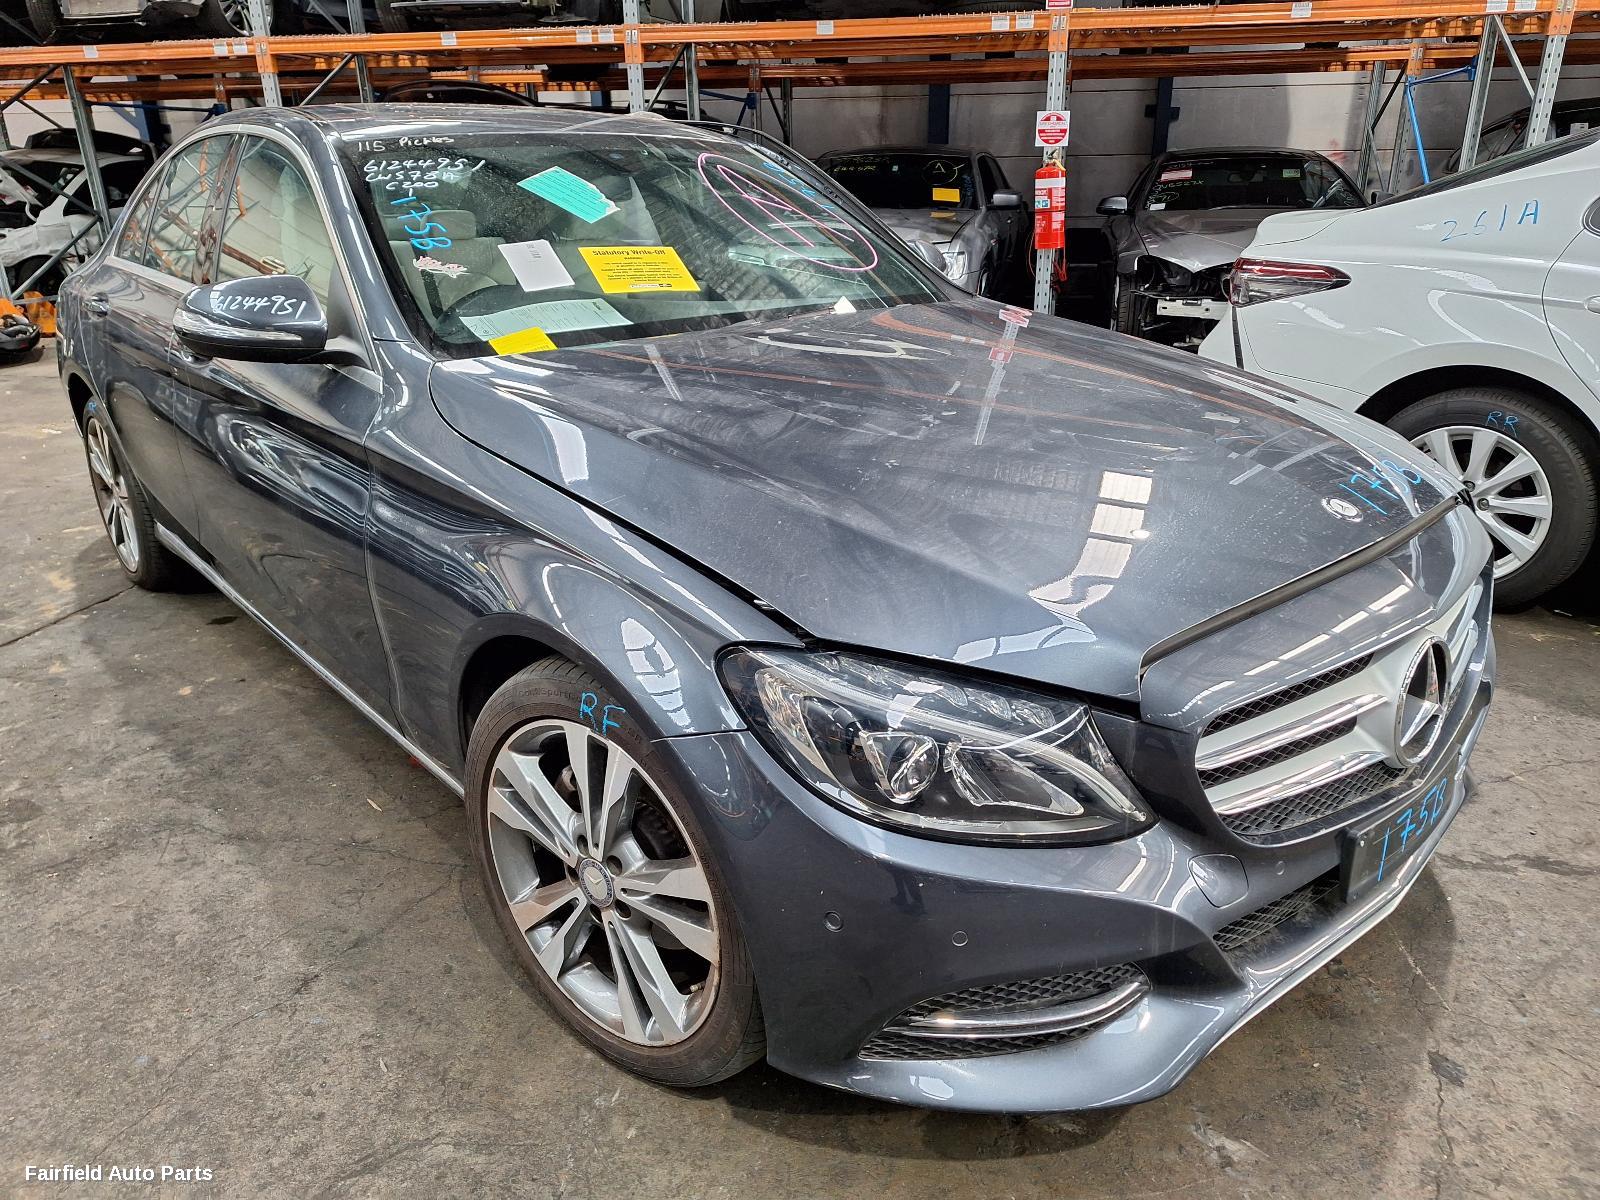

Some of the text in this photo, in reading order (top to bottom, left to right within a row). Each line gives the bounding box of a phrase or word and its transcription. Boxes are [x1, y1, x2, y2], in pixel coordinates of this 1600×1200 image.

[363, 157, 486, 172] 61244951
[214, 295, 307, 319] 61244951
[579, 691, 627, 737] RF
